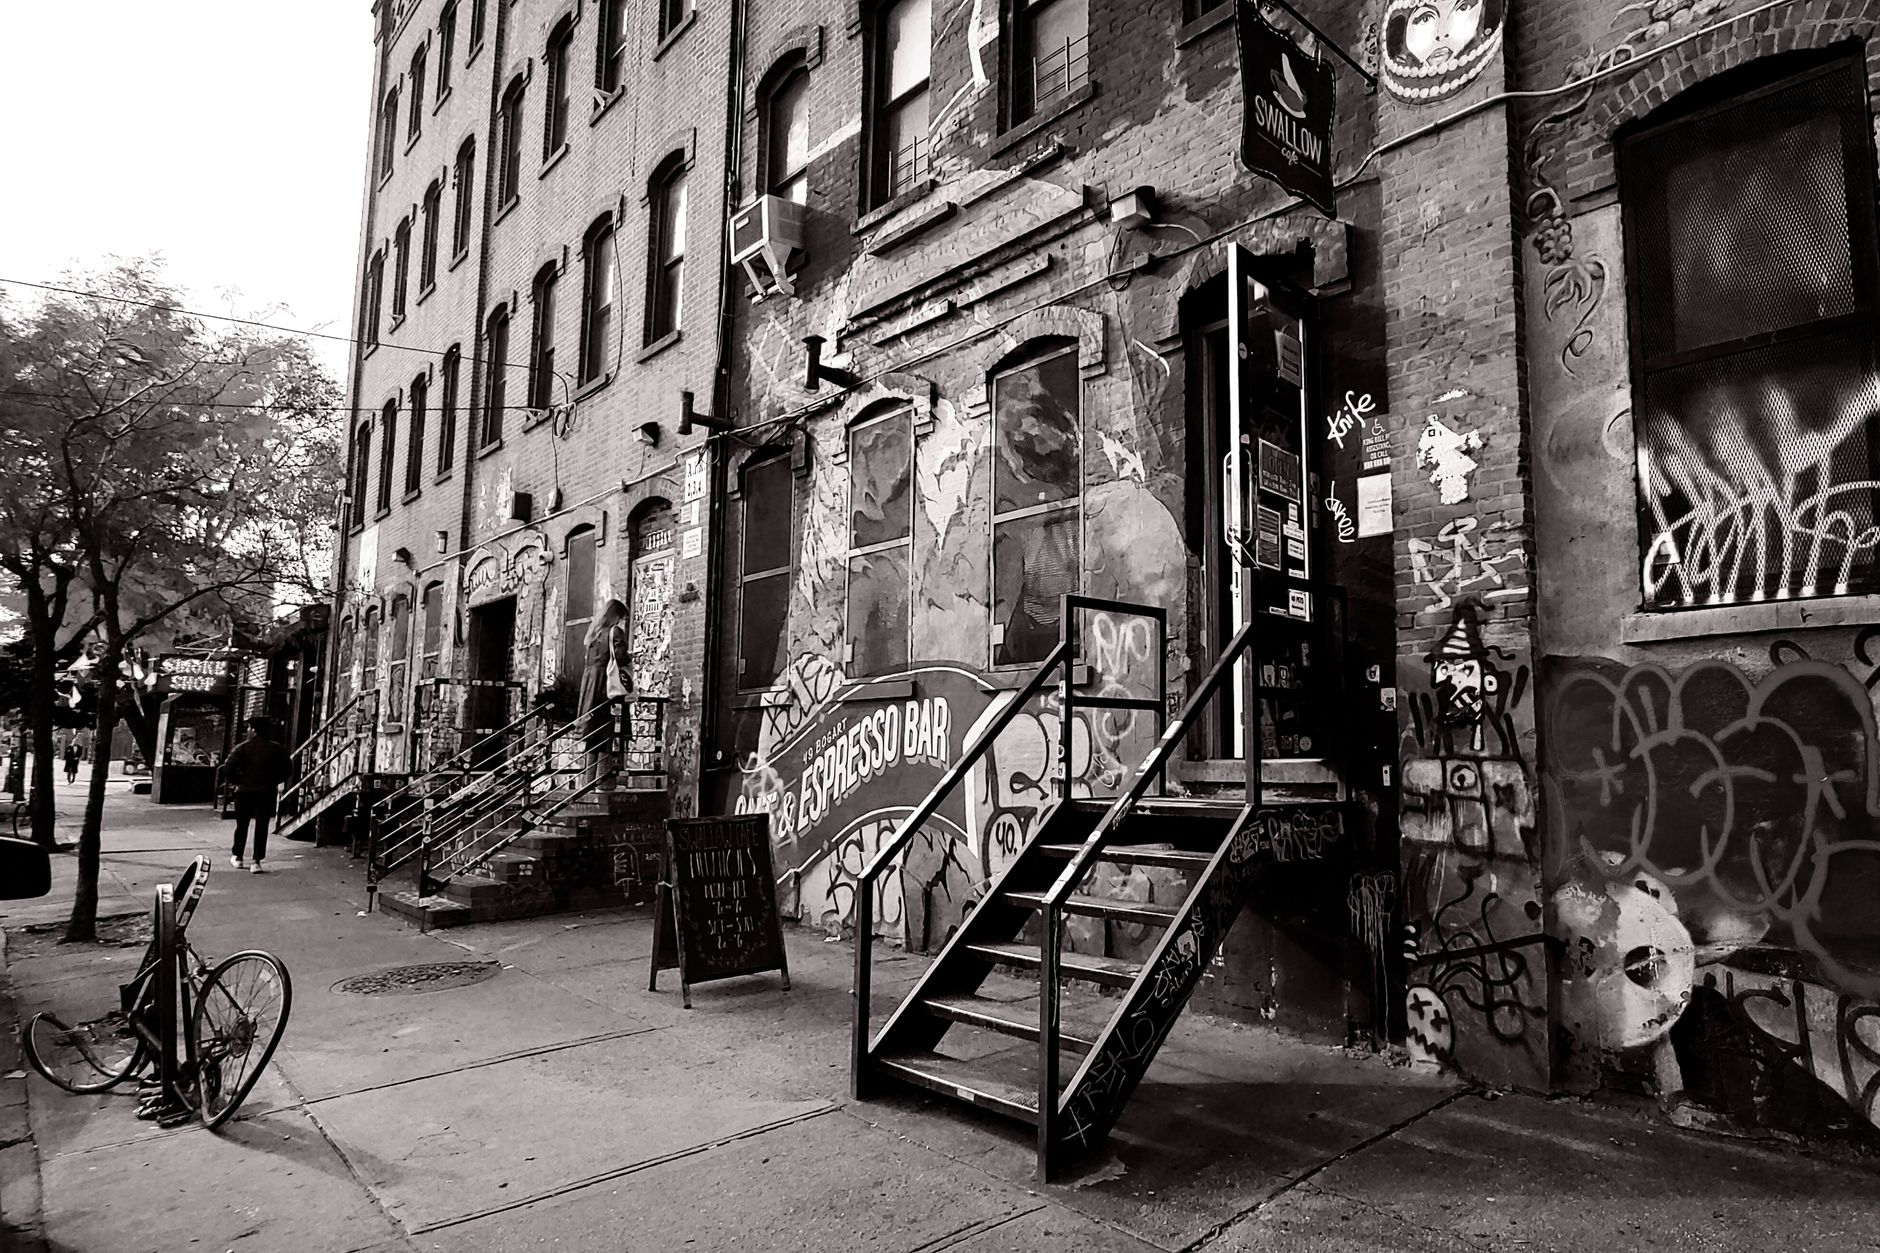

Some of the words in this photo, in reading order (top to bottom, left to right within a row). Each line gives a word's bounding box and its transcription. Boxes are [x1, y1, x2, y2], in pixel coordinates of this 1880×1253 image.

[1254, 94, 1322, 165] SWALLOW
[1281, 147, 1299, 166] cafe
[1327, 390, 1376, 449] Knife
[169, 675, 217, 692] SHOP
[778, 791, 796, 837] &
[797, 704, 901, 833] ESPRESSO
[903, 697, 949, 764] BAR
[802, 749, 814, 765] 49
[815, 717, 848, 753] BOGART
